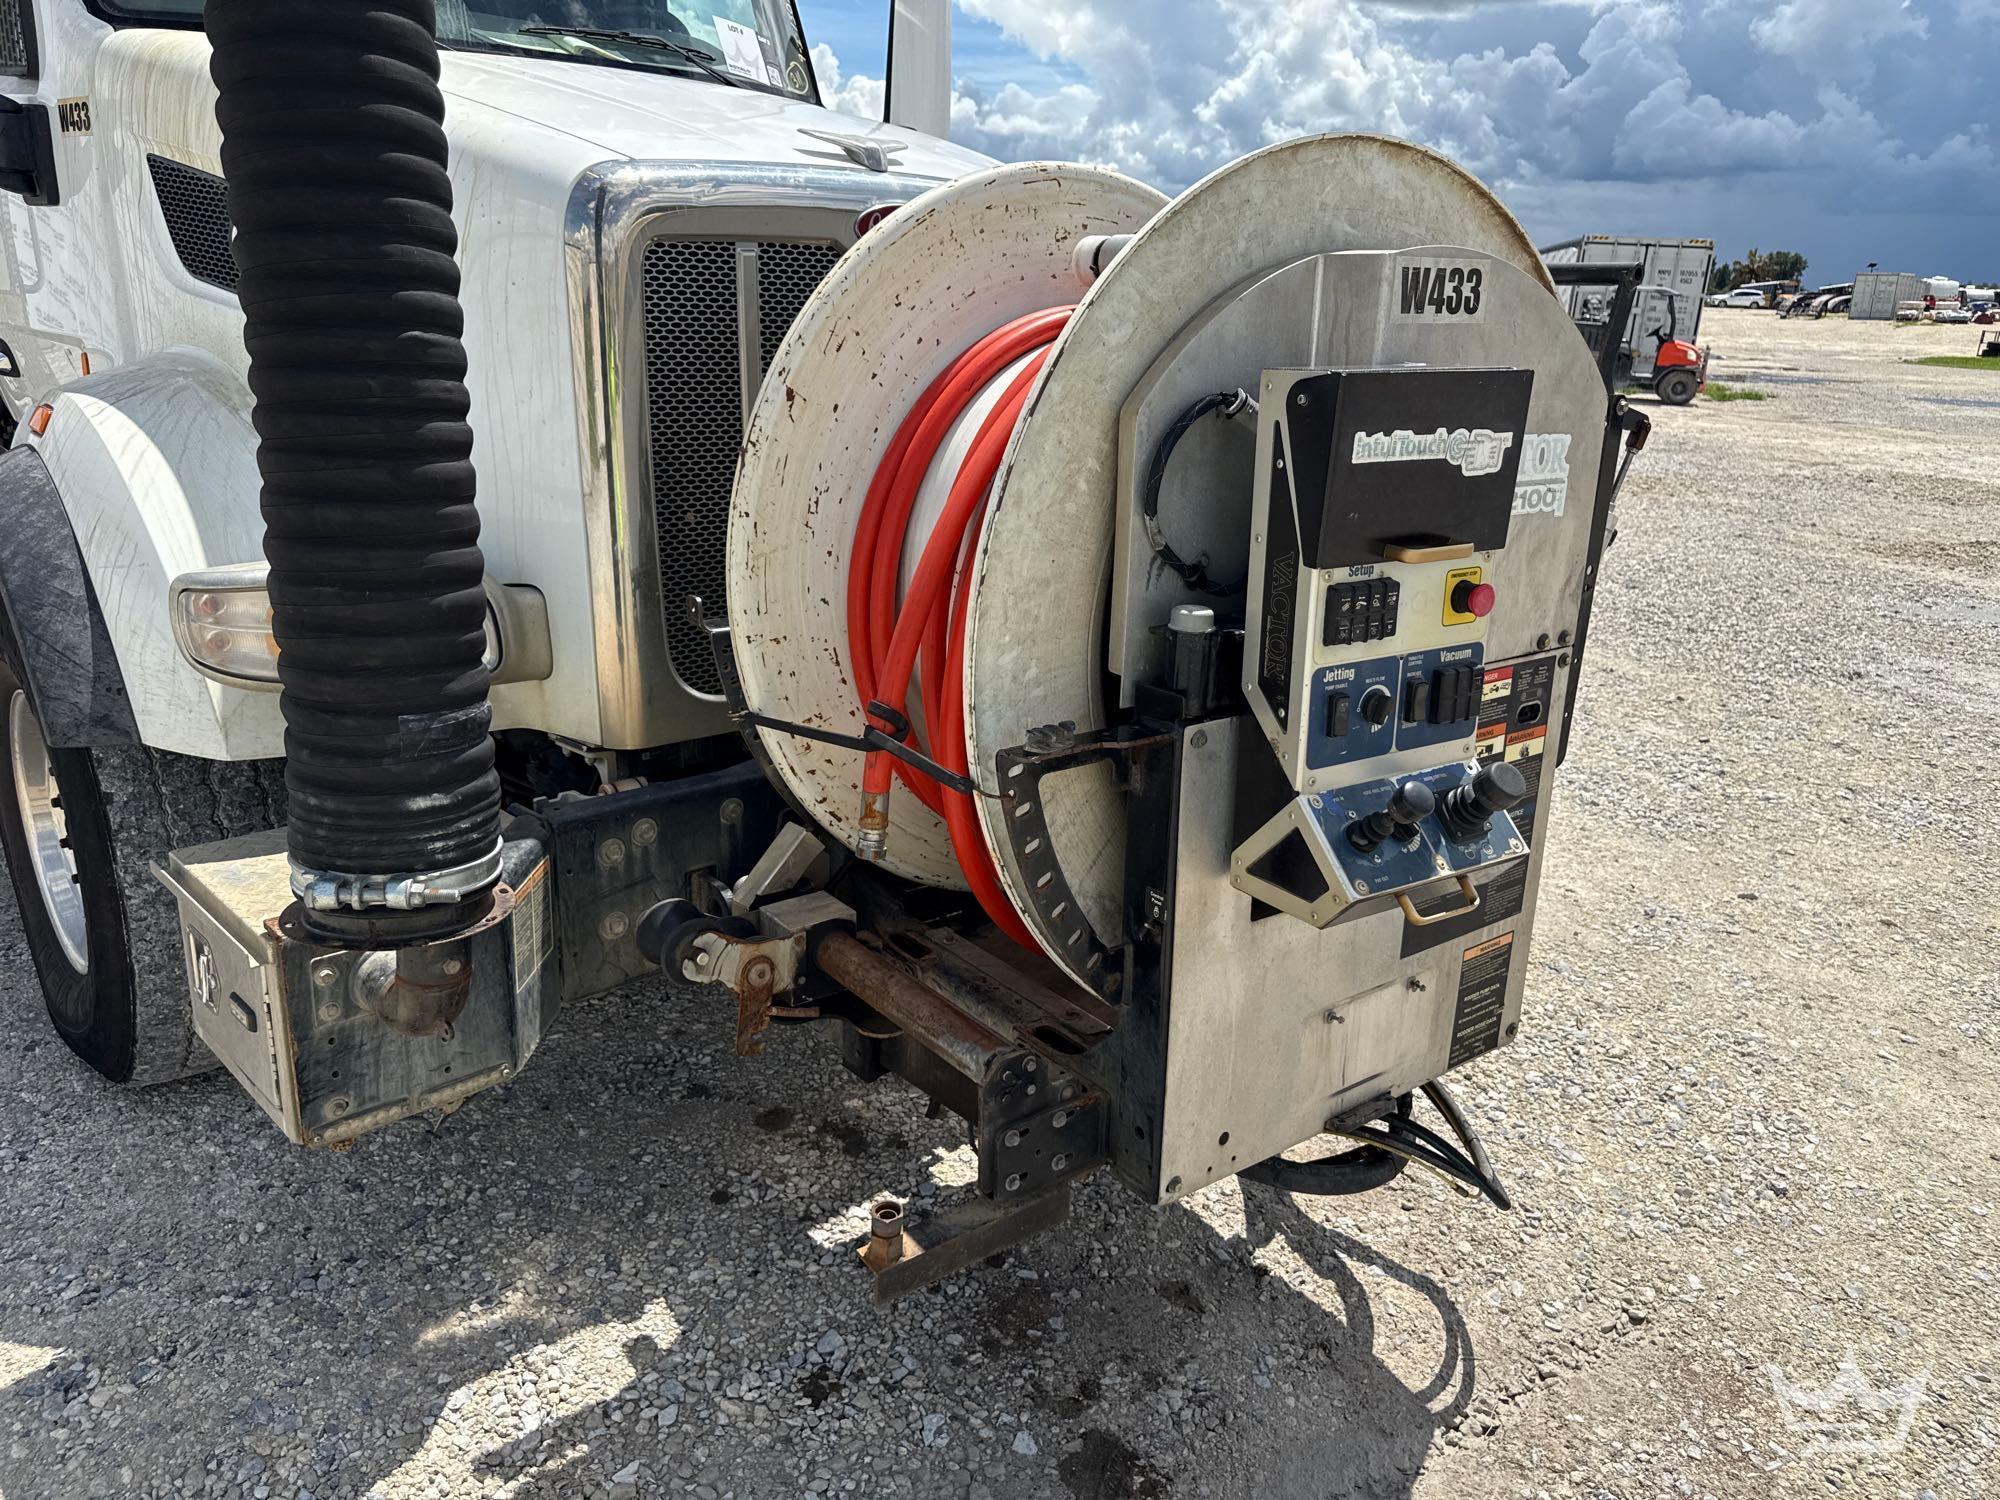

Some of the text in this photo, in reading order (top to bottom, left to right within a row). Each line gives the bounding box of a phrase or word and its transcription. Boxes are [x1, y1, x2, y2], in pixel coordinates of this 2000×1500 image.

[58, 101, 91, 132] W433
[1401, 267, 1482, 314] W433
[1349, 565, 1374, 578] Setup
[1261, 551, 1294, 678] VACTOR
[1440, 649, 1472, 662] Vacuum
[1323, 667, 1355, 683] Jetting
